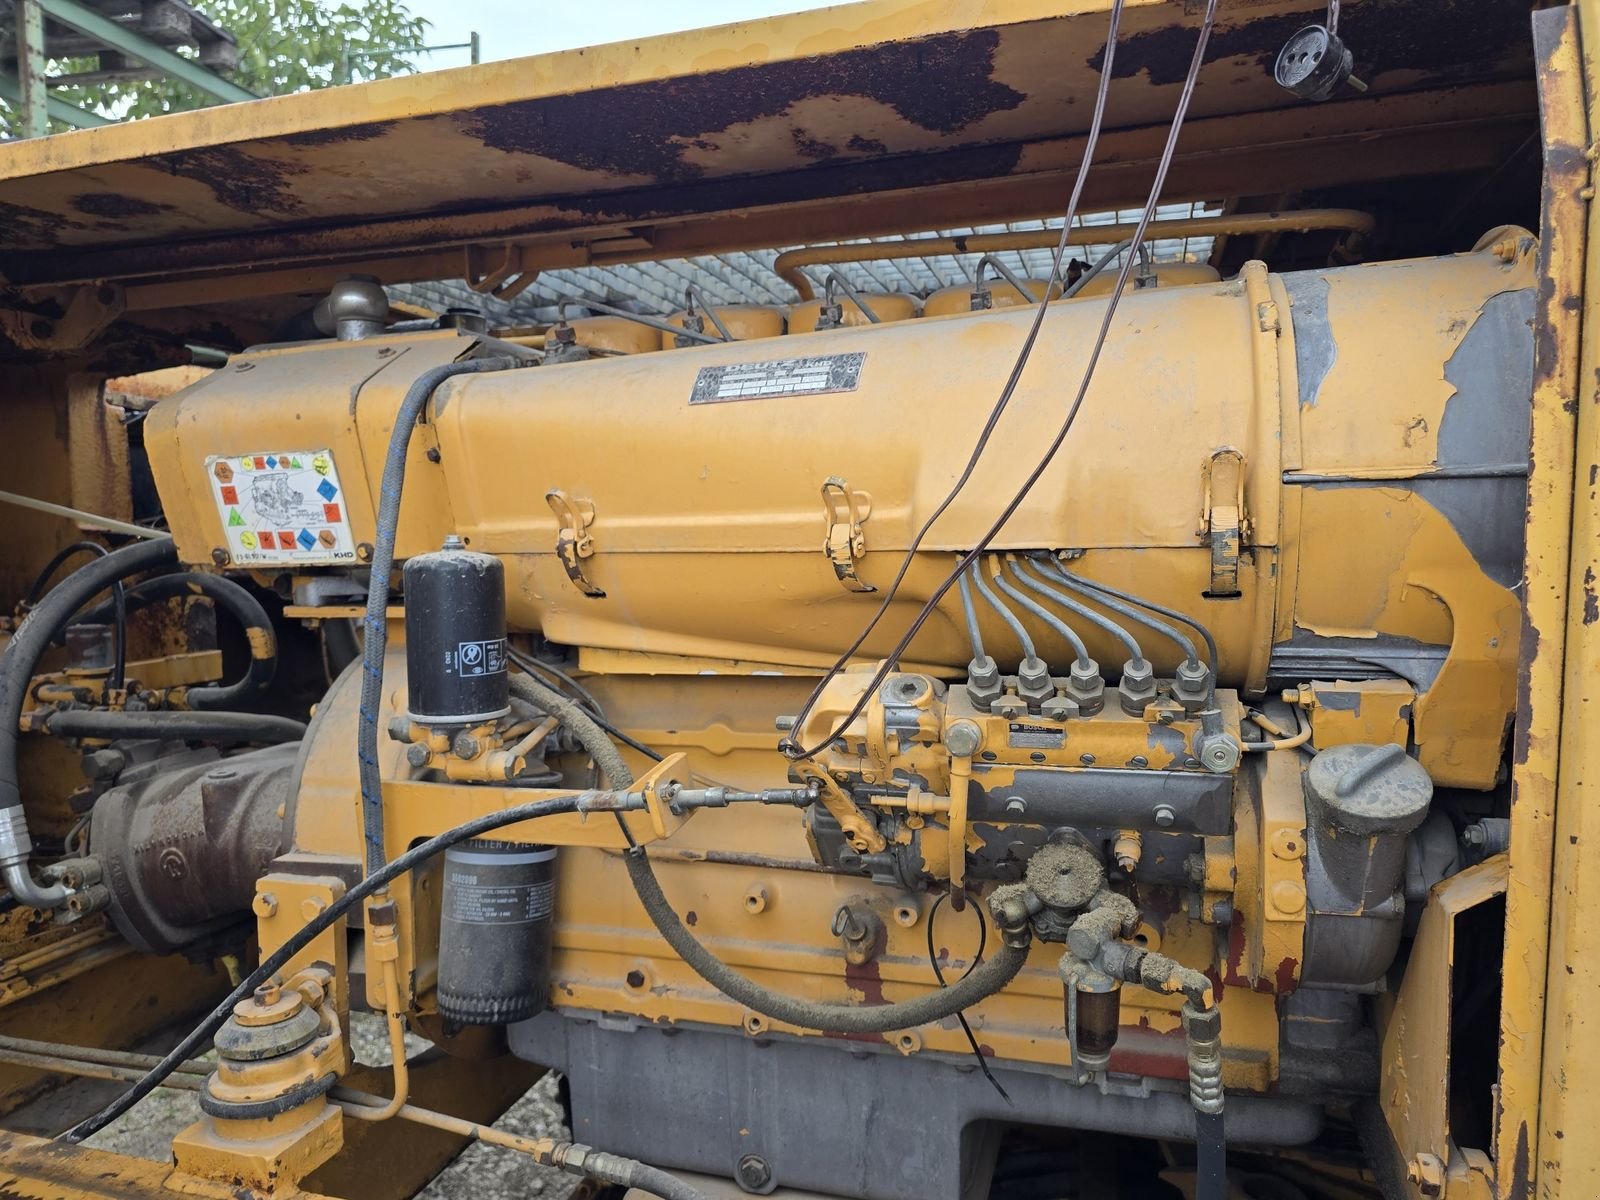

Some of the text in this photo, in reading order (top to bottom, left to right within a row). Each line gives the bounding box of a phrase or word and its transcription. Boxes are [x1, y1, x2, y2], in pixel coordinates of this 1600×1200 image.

[726, 360, 832, 371] DEUTZ KHD
[469, 839, 502, 849] FILTER
